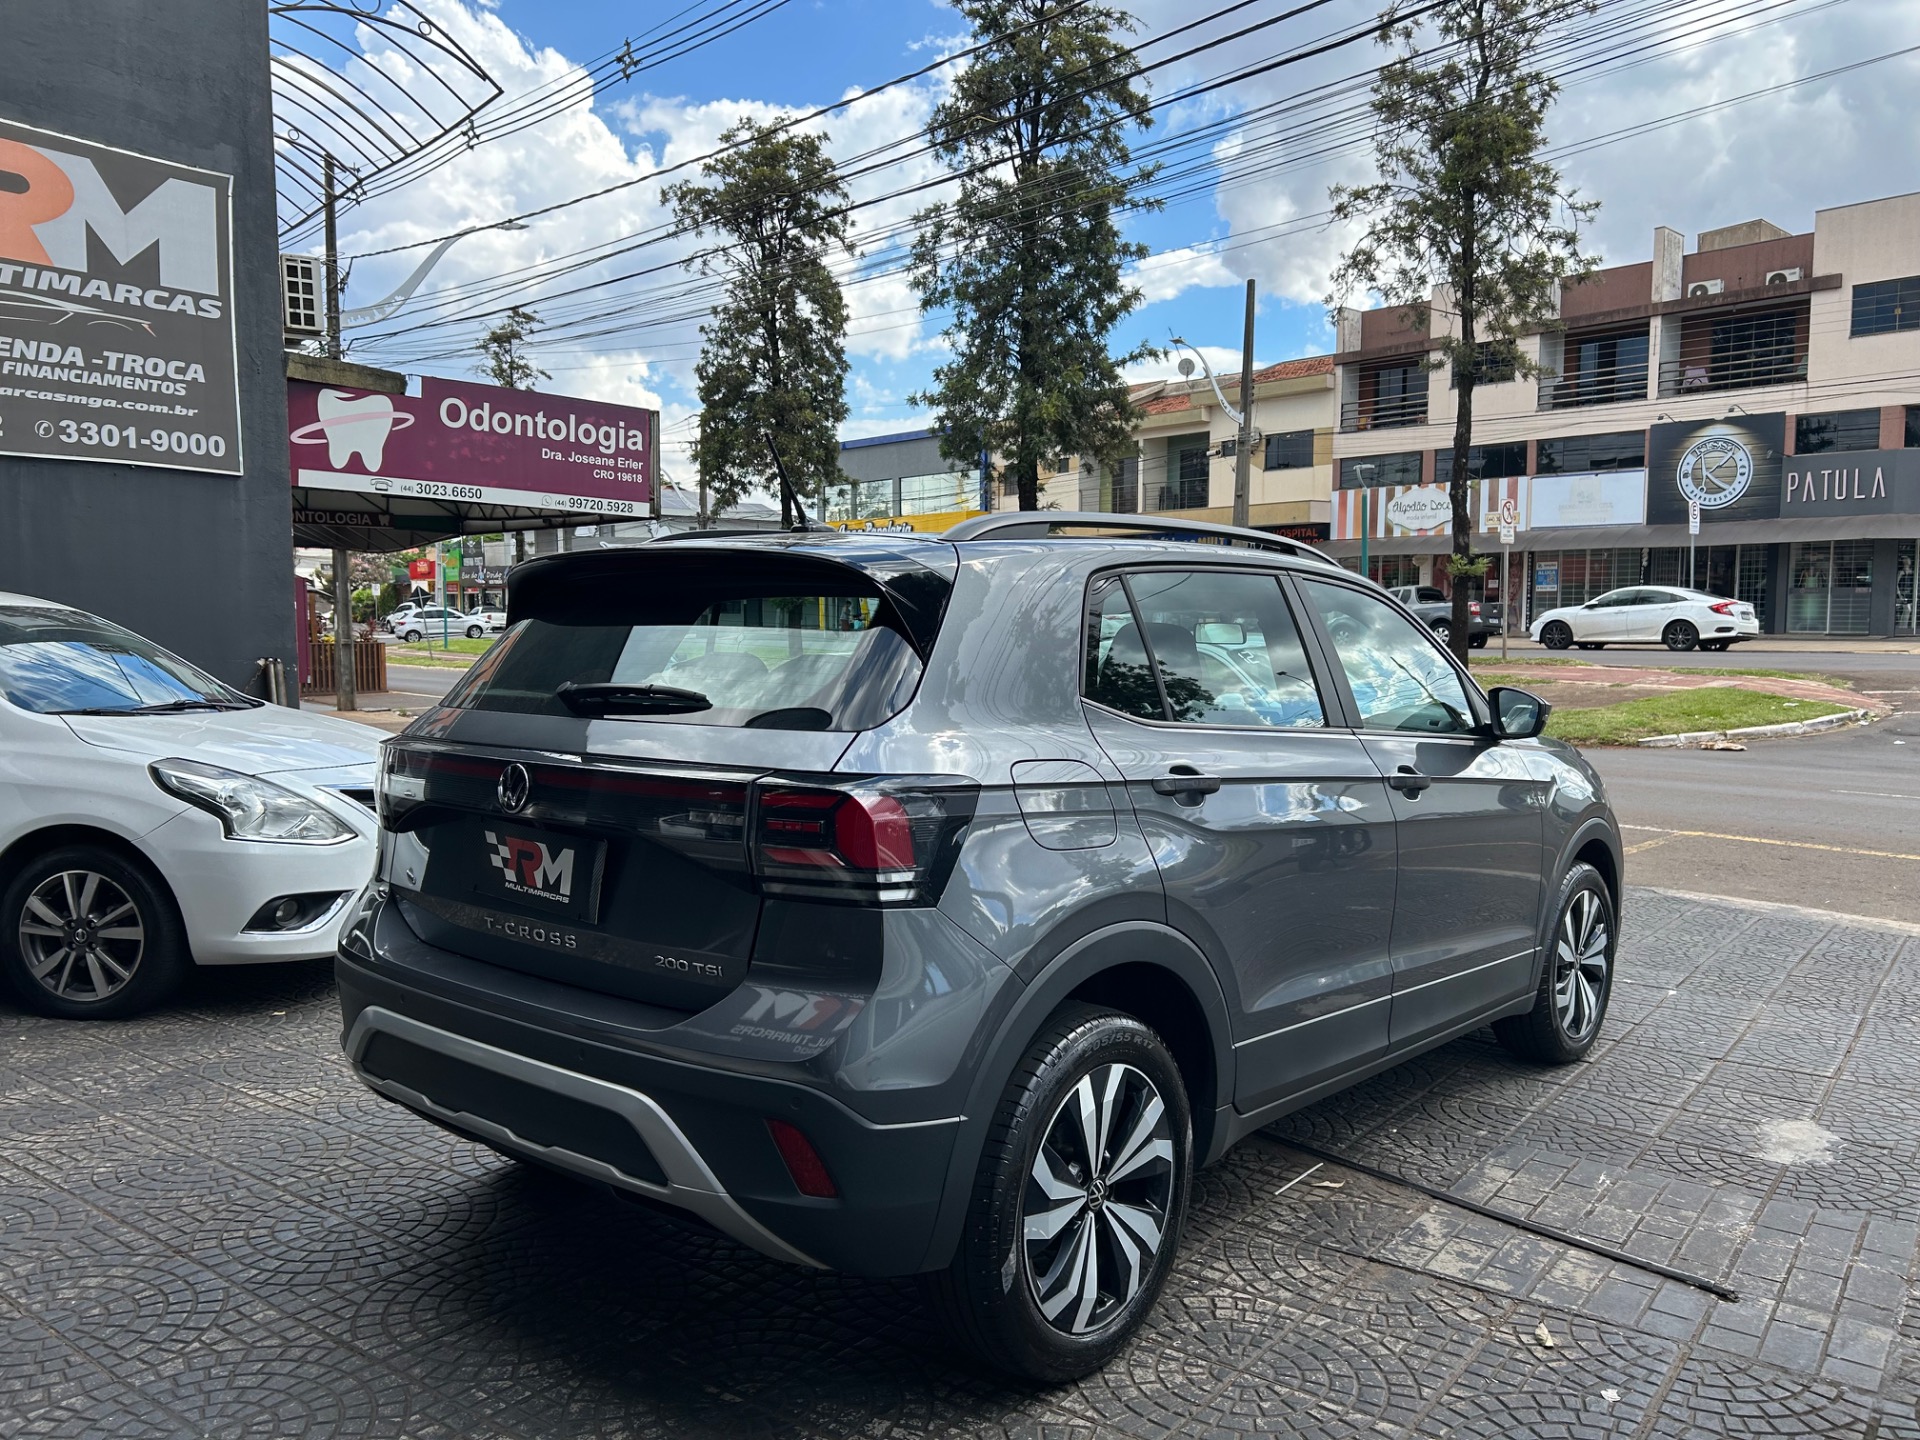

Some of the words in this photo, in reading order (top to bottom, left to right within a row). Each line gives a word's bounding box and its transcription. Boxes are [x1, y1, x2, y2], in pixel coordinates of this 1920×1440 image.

[2, 360, 187, 396] FINANCIAMENTOS
[439, 397, 643, 455] Odontologia
[58, 419, 226, 457] 3301-9000
[541, 448, 565, 461] Dra.
[568, 451, 615, 467] Joseane
[617, 457, 643, 471] Erler
[593, 469, 615, 480] CRO
[616, 473, 643, 483] 19618
[1787, 467, 1886, 503] PATULA
[400, 484, 414, 493] (44)
[416, 483, 482, 499] 3023.6650
[554, 500, 567, 508] (44)
[569, 497, 634, 514] 99720.5928
[1392, 500, 1427, 516] Algodão
[505, 836, 575, 895] RM
[504, 881, 570, 904] MULTIMARCAS
[484, 916, 577, 949] T-CROSS
[654, 955, 689, 971] 200
[692, 962, 723, 977] TSI
[1084, 1033, 1131, 1057] 205/55
[1133, 1035, 1155, 1049] R17
